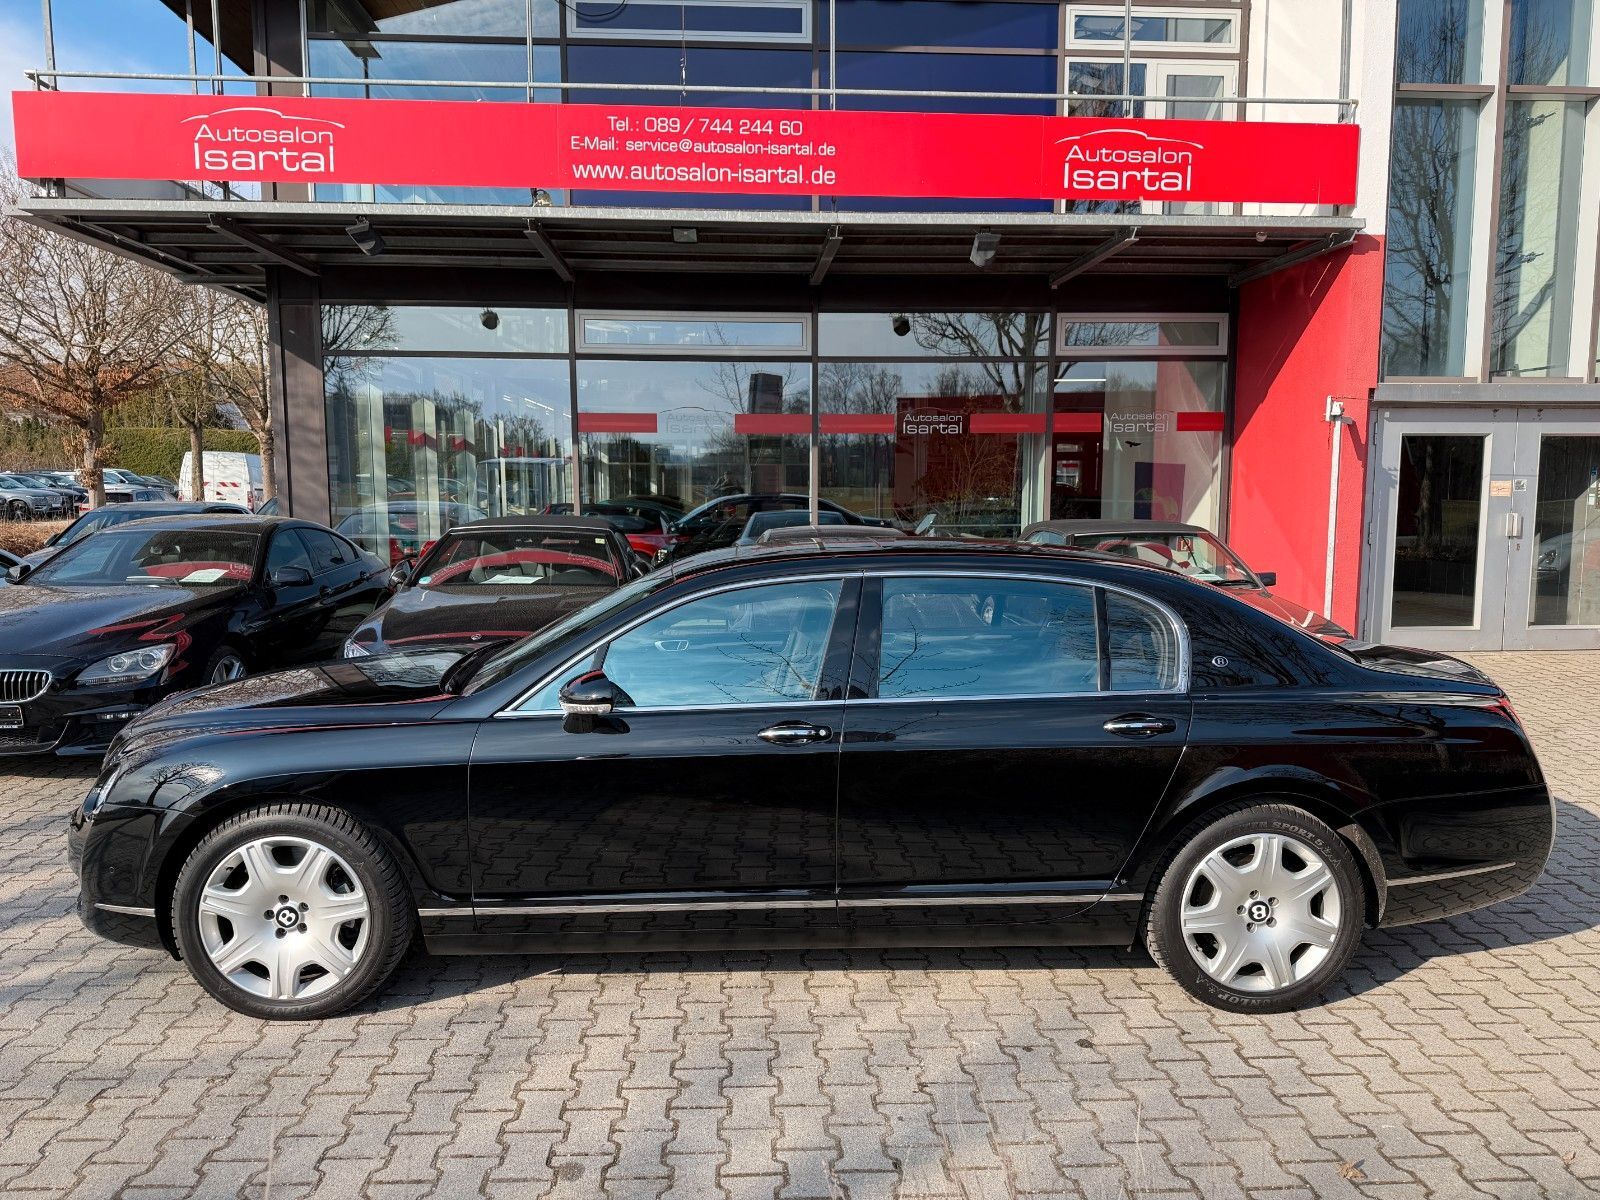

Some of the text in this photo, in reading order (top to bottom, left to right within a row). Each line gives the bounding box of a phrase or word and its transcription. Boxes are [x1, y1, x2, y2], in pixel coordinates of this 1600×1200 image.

[194, 123, 334, 144] Autosalon
[607, 116, 803, 136] Tel.: 089 / 744 244 60
[571, 135, 836, 156] E-Mail: service@autosalon-isartal.de
[1065, 145, 1192, 164] Autosalon
[194, 142, 335, 172] Isartal
[572, 162, 836, 185] www.autosalon-isartal.de
[1063, 162, 1192, 191] Isartal
[903, 413, 963, 422] Autosalon
[1109, 412, 1169, 421] Autosalon
[902, 421, 963, 434] Isartal
[1109, 420, 1169, 433] Isartal
[1273, 821, 1315, 838] SPORT
